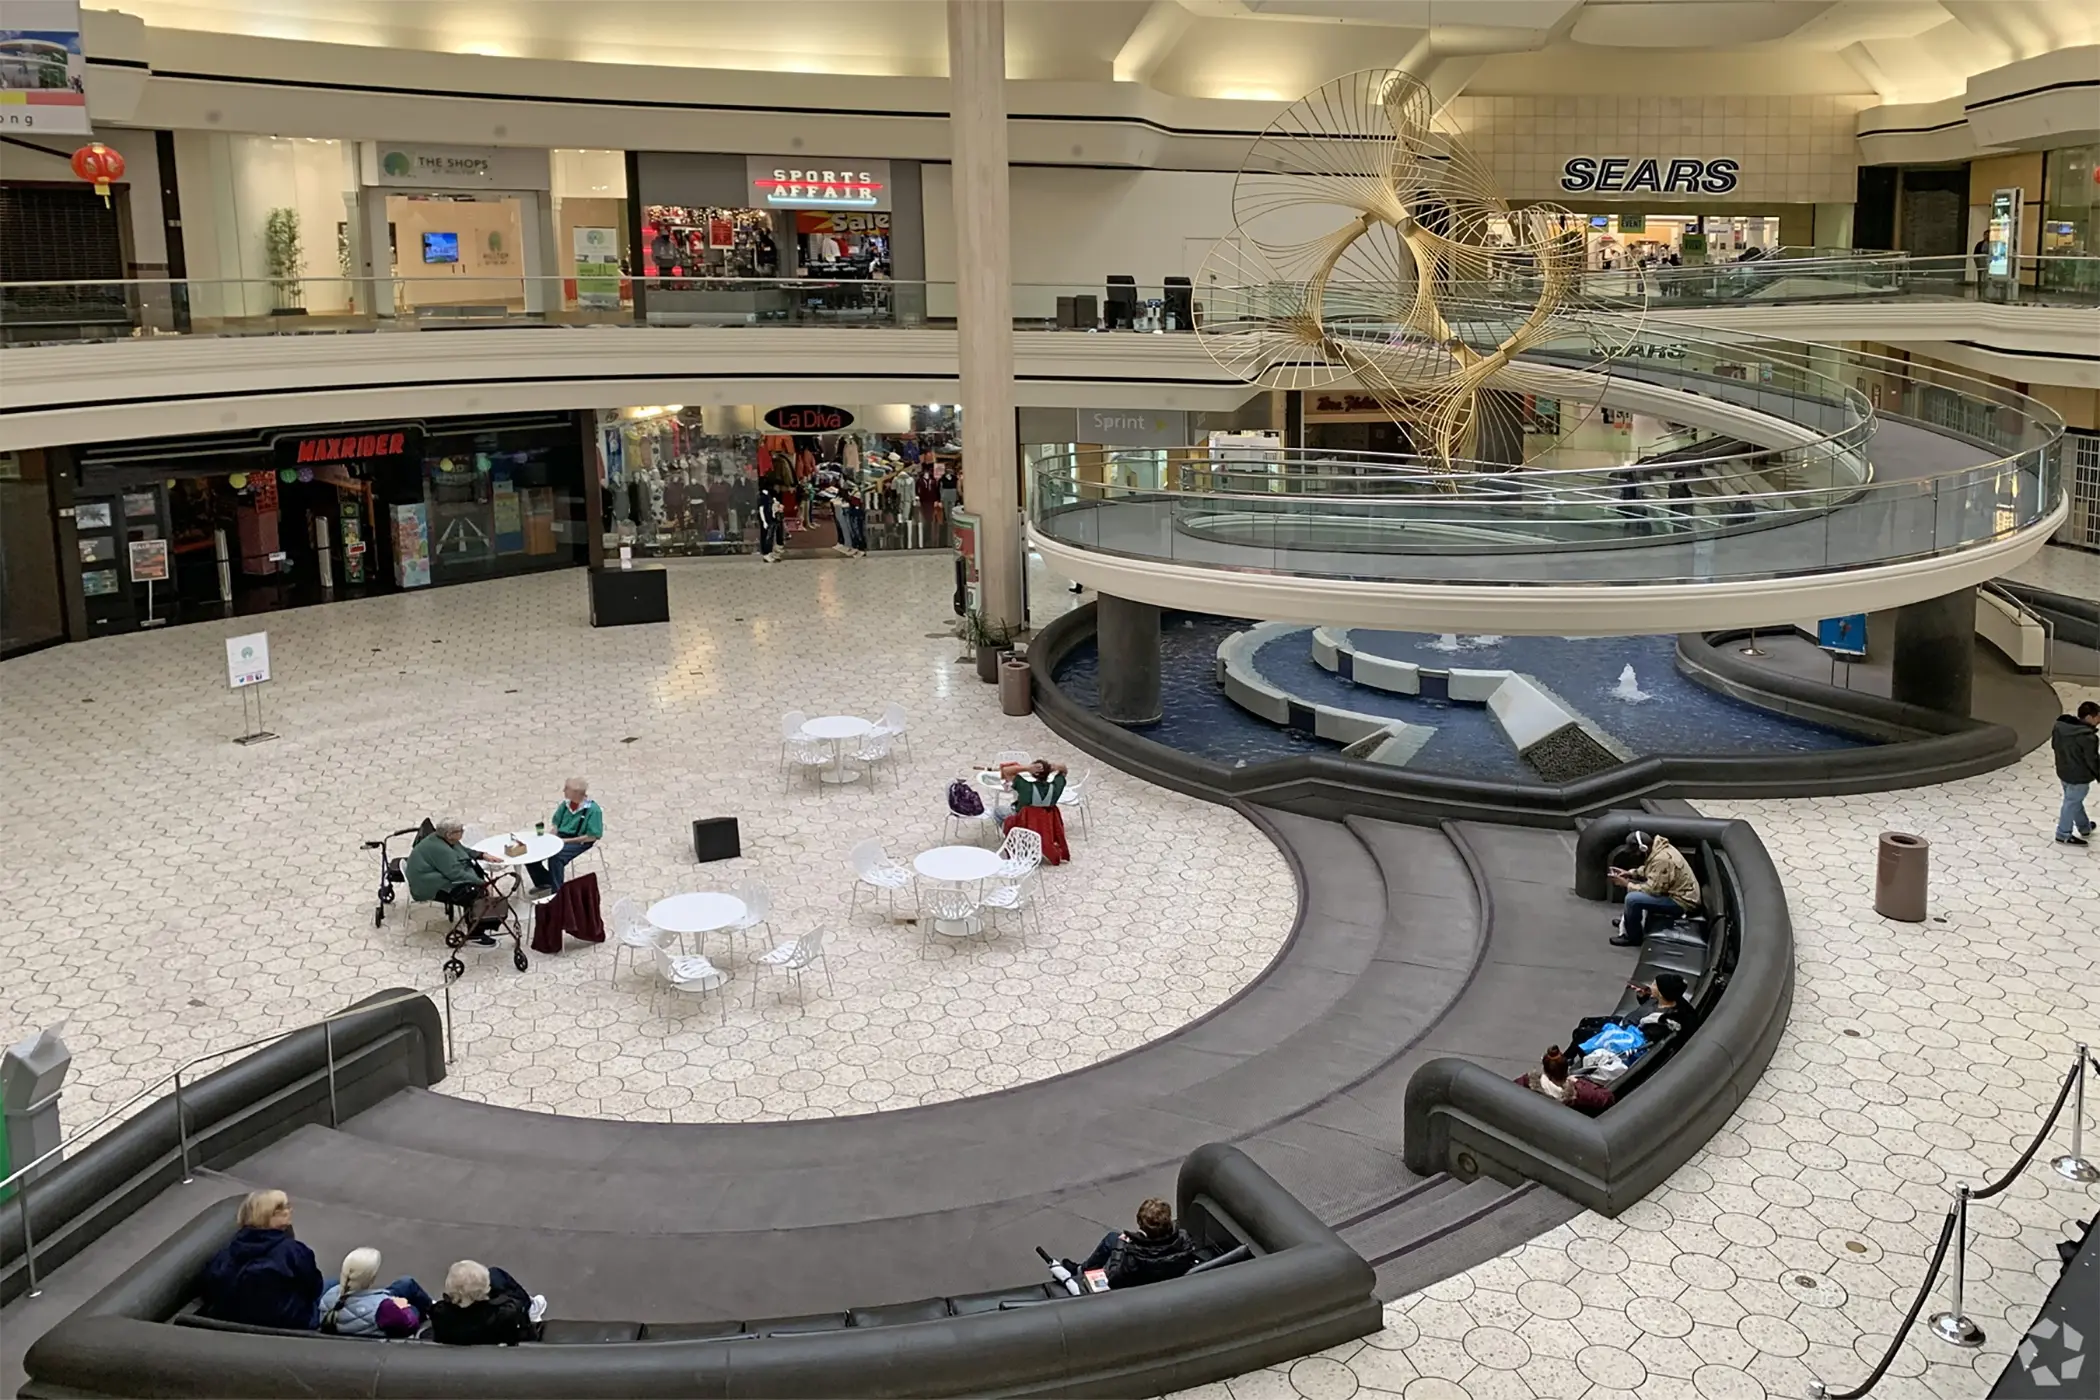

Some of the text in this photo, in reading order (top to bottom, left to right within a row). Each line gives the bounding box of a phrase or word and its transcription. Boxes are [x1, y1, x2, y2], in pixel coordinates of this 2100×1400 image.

[418, 157, 488, 170] THE SHOPS
[773, 169, 871, 184] SPORTS
[1560, 157, 1739, 194] SEARS
[773, 185, 873, 199] AFFAIR
[830, 211, 890, 233] Sale
[1622, 219, 1642, 229] EVENT
[779, 409, 841, 429] La Diva
[1094, 412, 1146, 432] Sprint
[297, 433, 405, 463] MAXRIDER
